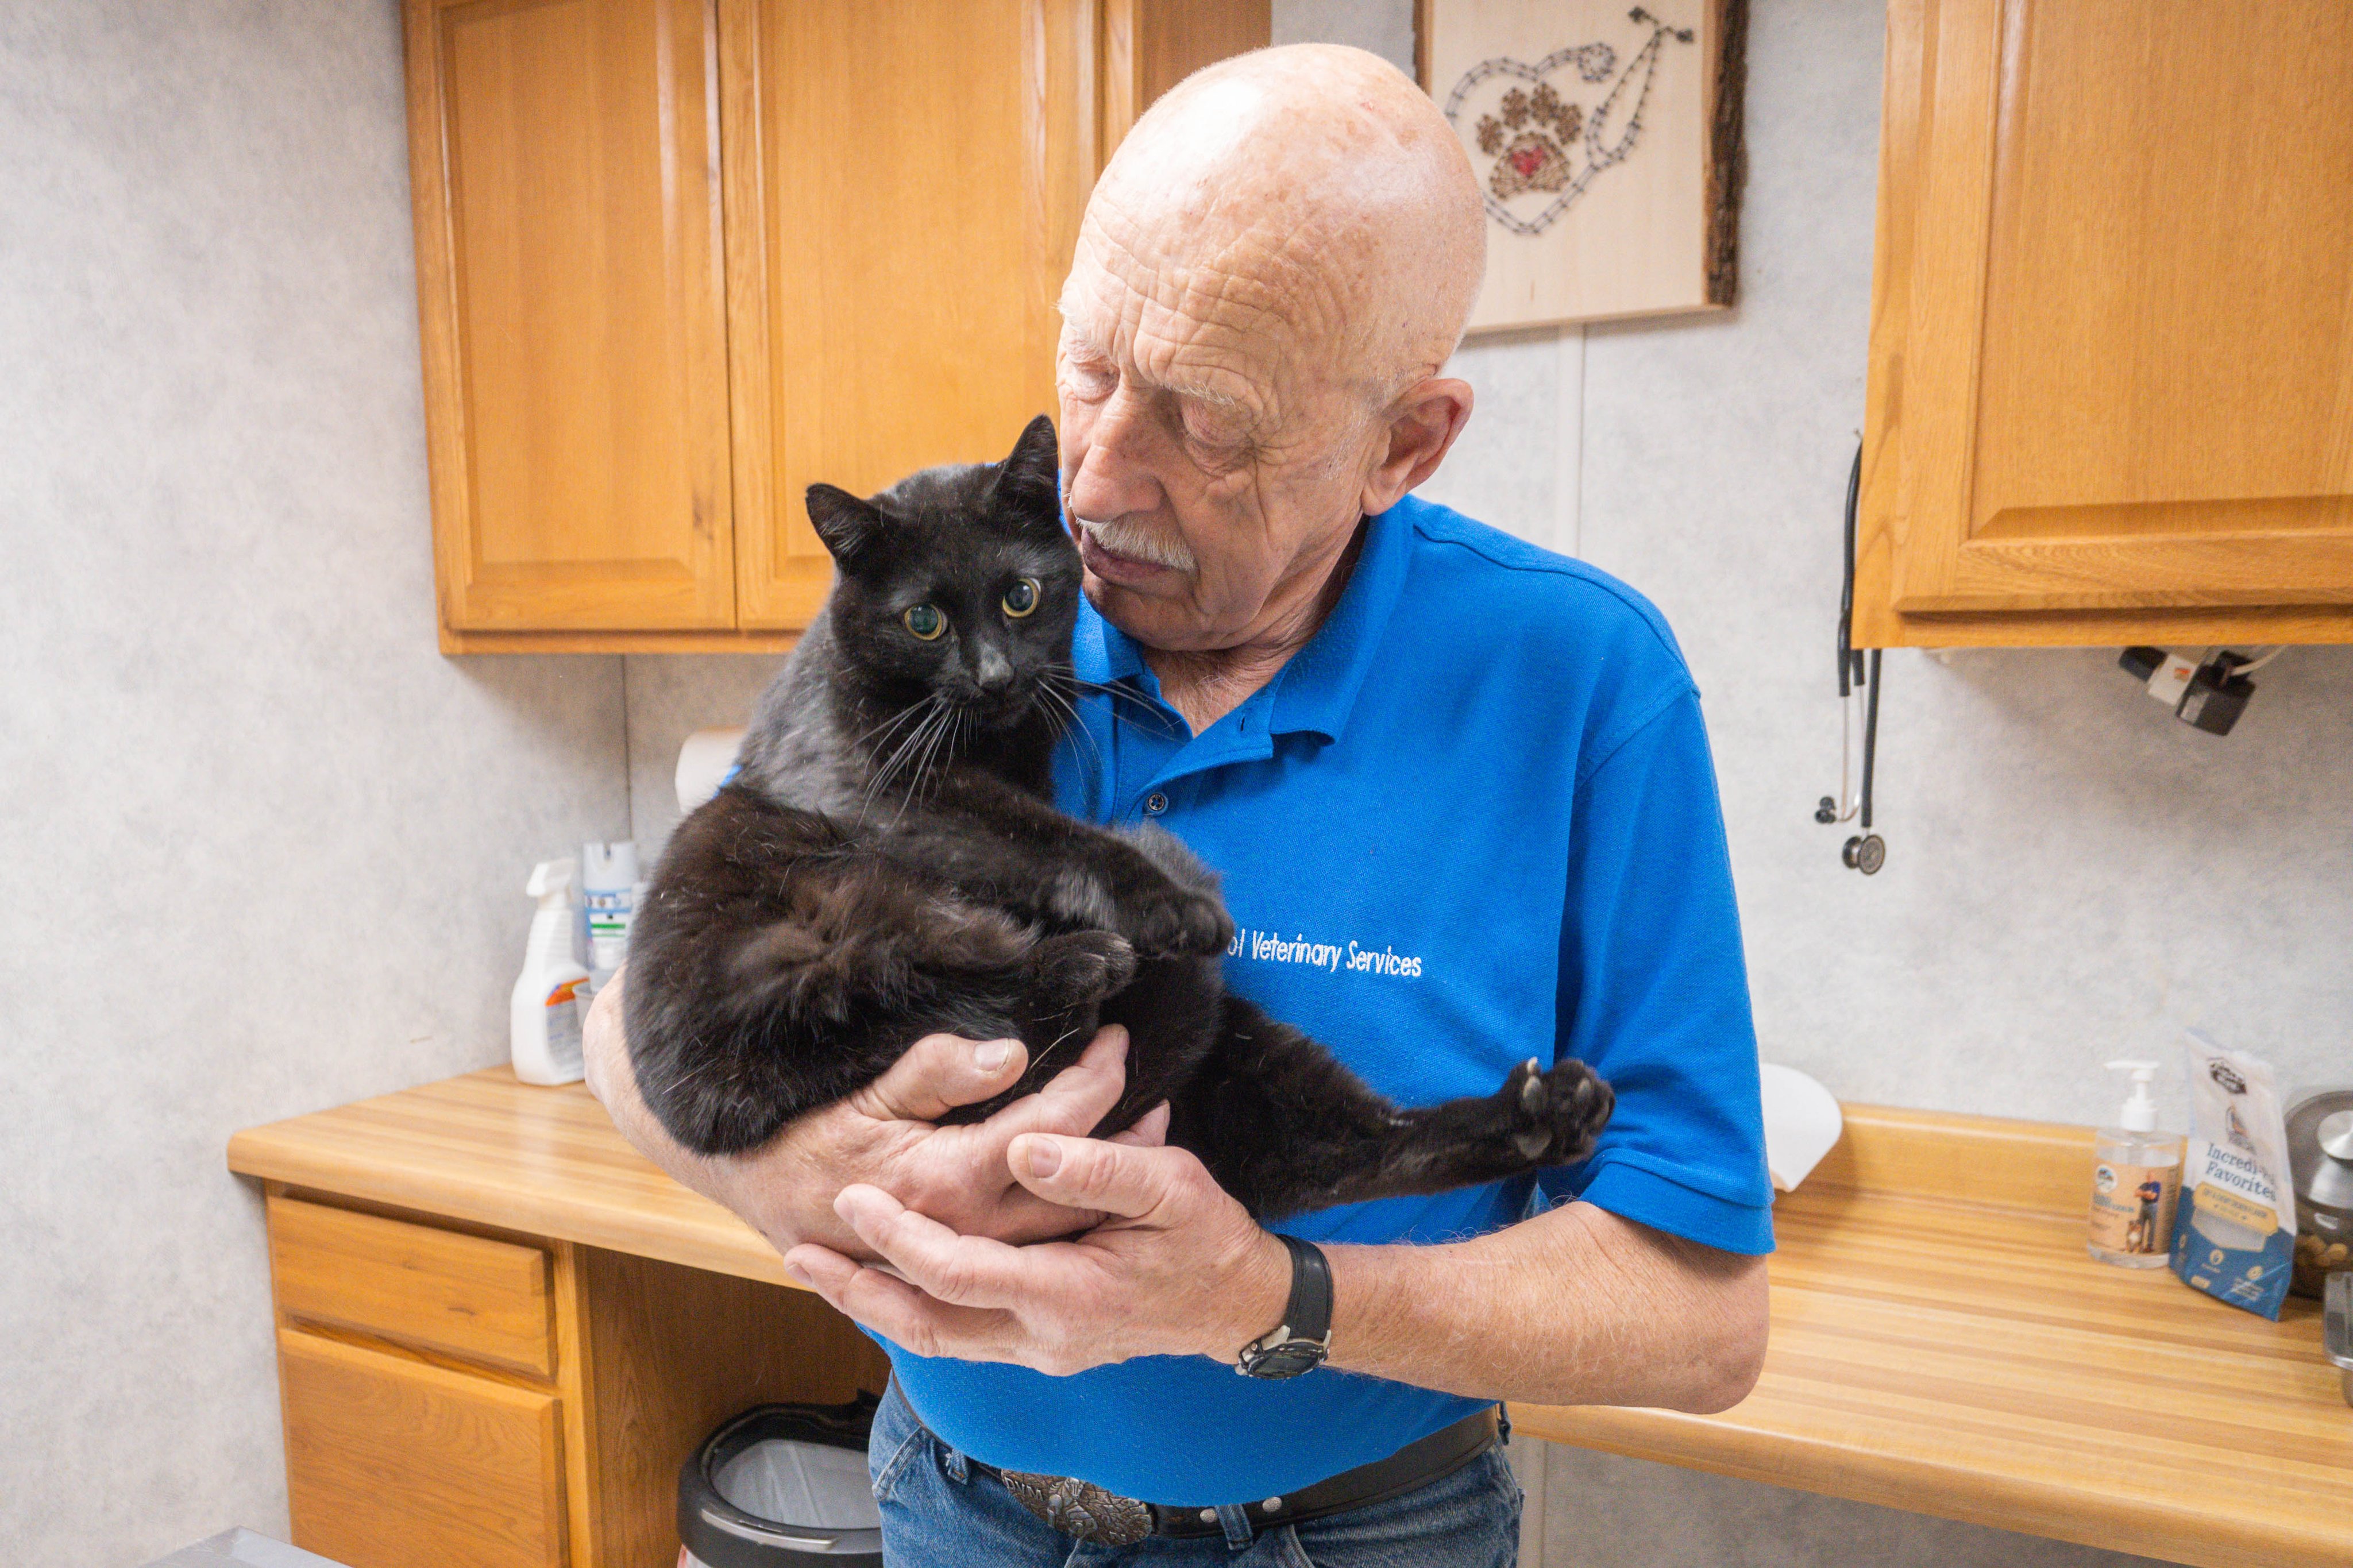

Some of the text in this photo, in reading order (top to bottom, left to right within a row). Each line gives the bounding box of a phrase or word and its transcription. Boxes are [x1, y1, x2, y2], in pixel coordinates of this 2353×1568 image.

[1252, 930, 1342, 972] Veterinary
[1346, 940, 1422, 978] Services
[2205, 1161, 2277, 1202] Favorites
[1004, 1476, 1043, 1501] DVM
